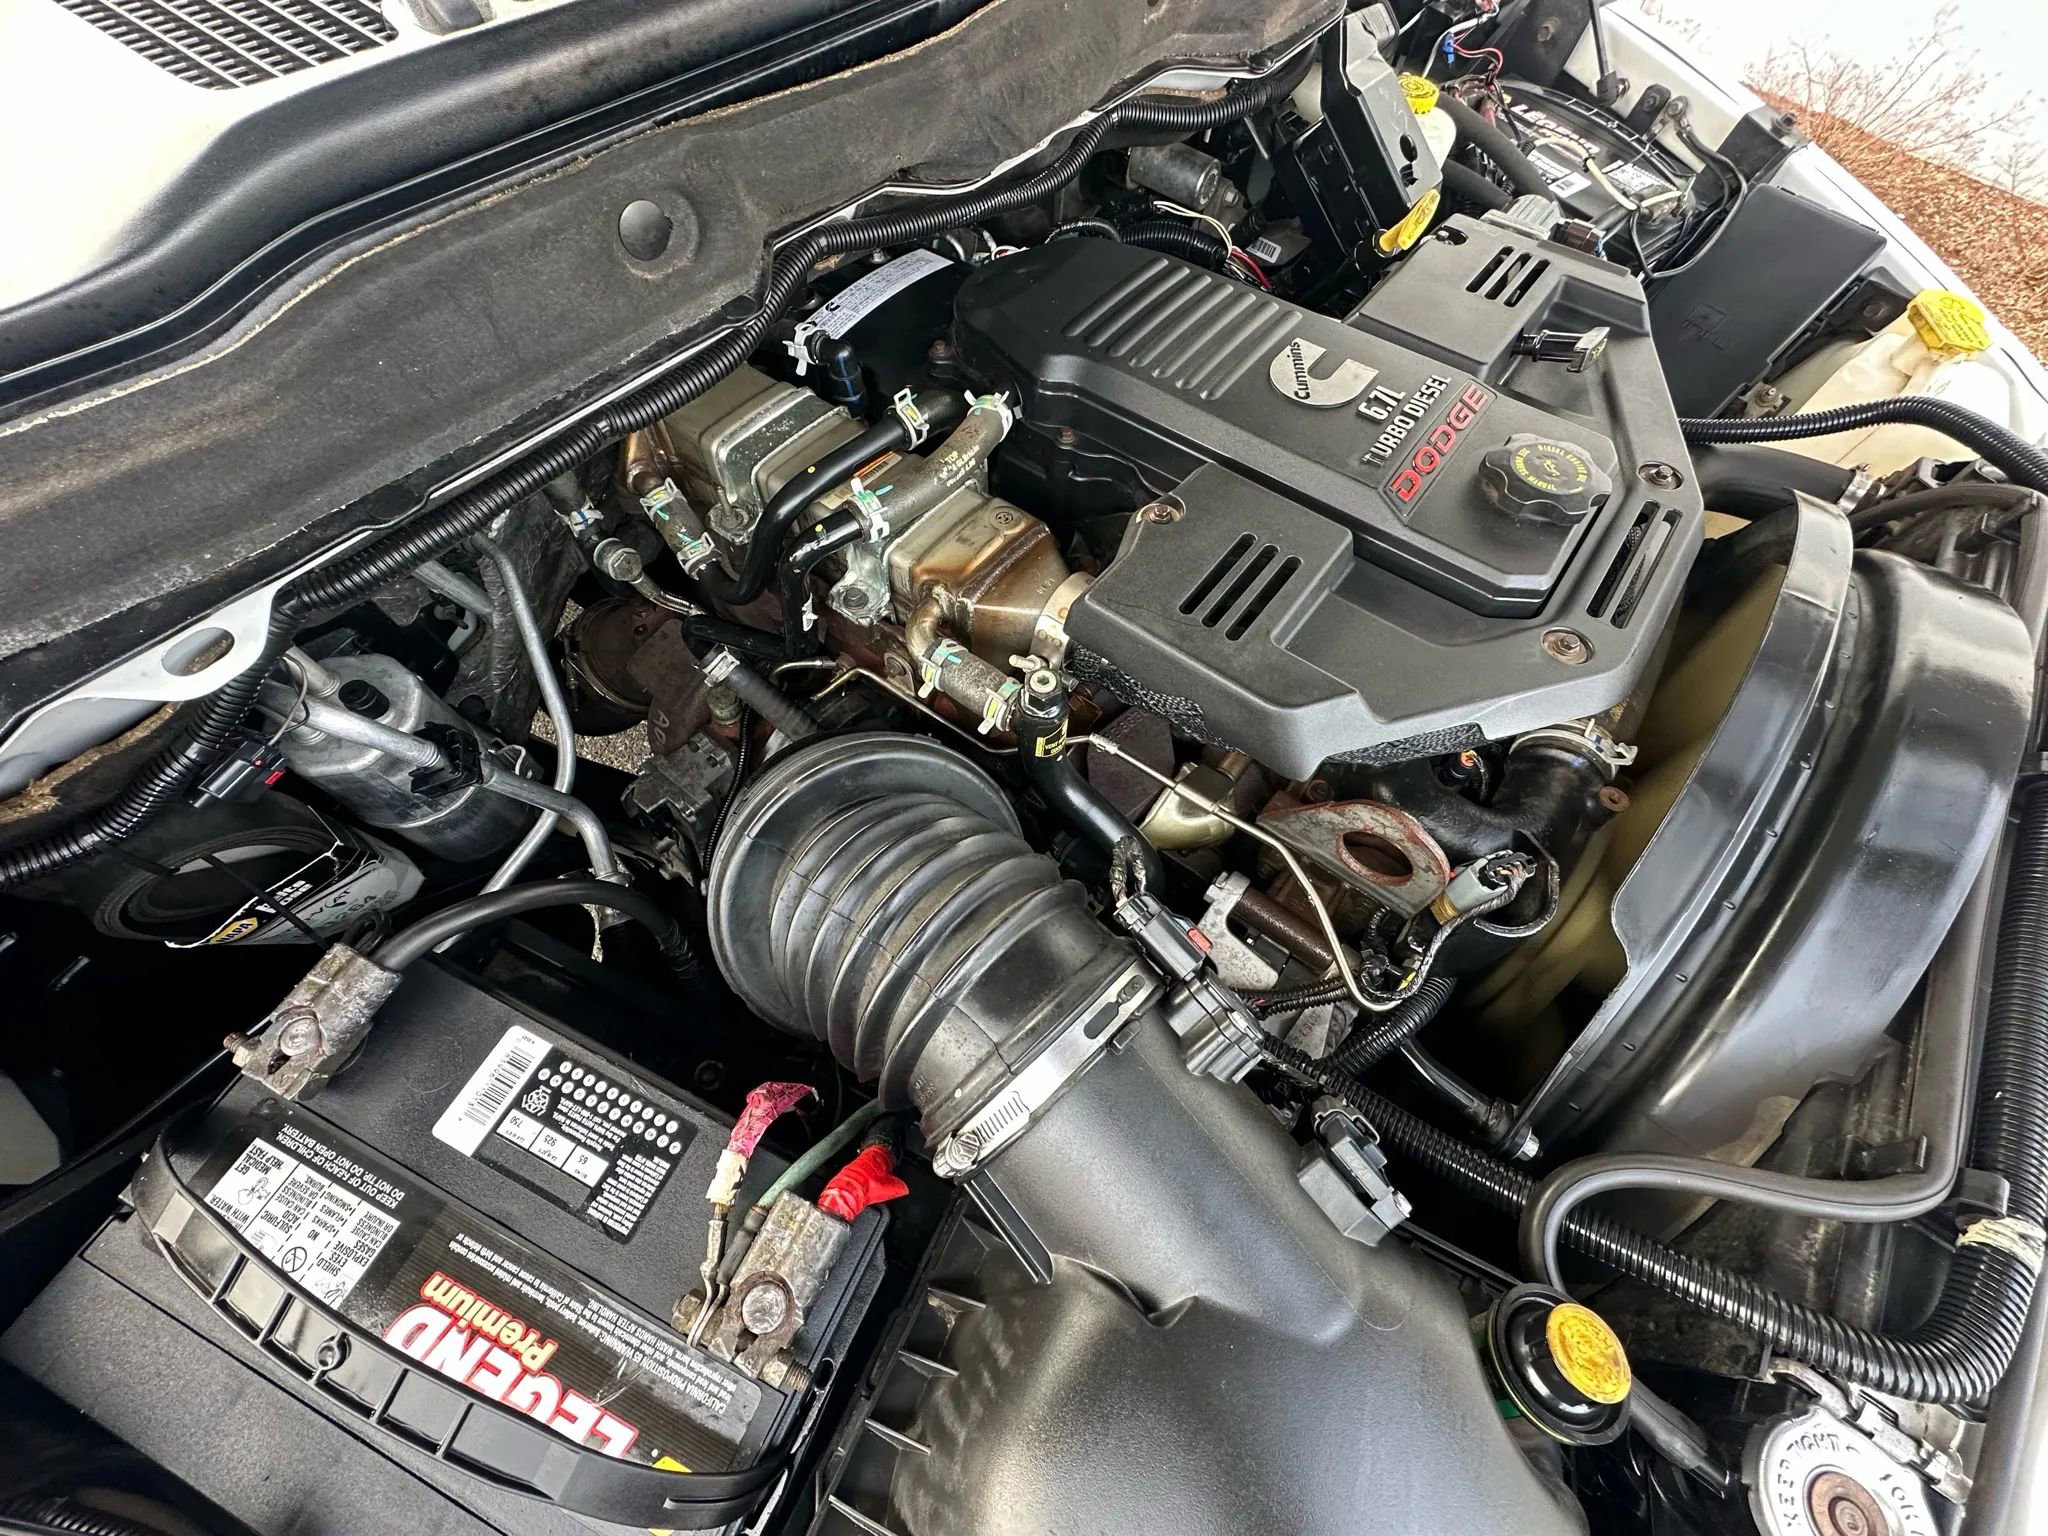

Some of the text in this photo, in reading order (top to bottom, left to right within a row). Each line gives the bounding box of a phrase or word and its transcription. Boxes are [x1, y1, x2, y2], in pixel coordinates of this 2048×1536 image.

[1287, 341, 1312, 400] Cummins
[1357, 385, 1406, 422] 6.7L
[1361, 374, 1452, 467] TURBO DIESEL
[1390, 384, 1489, 503] DODGE
[508, 1114, 524, 1128] 750
[273, 1131, 315, 1159] CHILDREN.
[542, 1133, 558, 1147] 925
[233, 1160, 251, 1175] GET
[240, 1152, 272, 1175] MEDICAL
[264, 1153, 284, 1170] HELP
[279, 1122, 405, 1201] DO NOT TIP. DO NOT OPEN BATTERY.
[310, 1152, 326, 1166] OF
[577, 1153, 588, 1165] 65
[286, 1177, 319, 1199] OR SEVERE
[346, 1174, 362, 1187] OF
[357, 1181, 378, 1197] OUT
[273, 1192, 306, 1215] CAN CAUSE
[280, 1184, 313, 1207] BLINDNESS
[374, 1191, 398, 1209] KEEP
[229, 1207, 250, 1223] WITH
[258, 1209, 293, 1234] SULFURIC
[280, 1209, 300, 1225] ACID
[306, 1228, 320, 1241] NO
[349, 1224, 383, 1248] CAN CAUSE
[355, 1217, 389, 1240] BLINDNESS
[382, 1222, 394, 1233] OR
[331, 1240, 370, 1267] EXPLOSIVE
[352, 1239, 377, 1257] GASES
[314, 1257, 341, 1277] SHIELD
[418, 1270, 558, 1374] Premium
[614, 1315, 638, 1334] AFTER
[595, 1329, 636, 1359] WARNING:
[633, 1326, 658, 1346] HANDS
[631, 1350, 644, 1364] 65
[653, 1338, 675, 1356] WASH
[381, 1301, 639, 1458] LEGEND
[638, 1355, 689, 1390] PROPOSITION
[682, 1381, 728, 1414] CALIFORNIA
